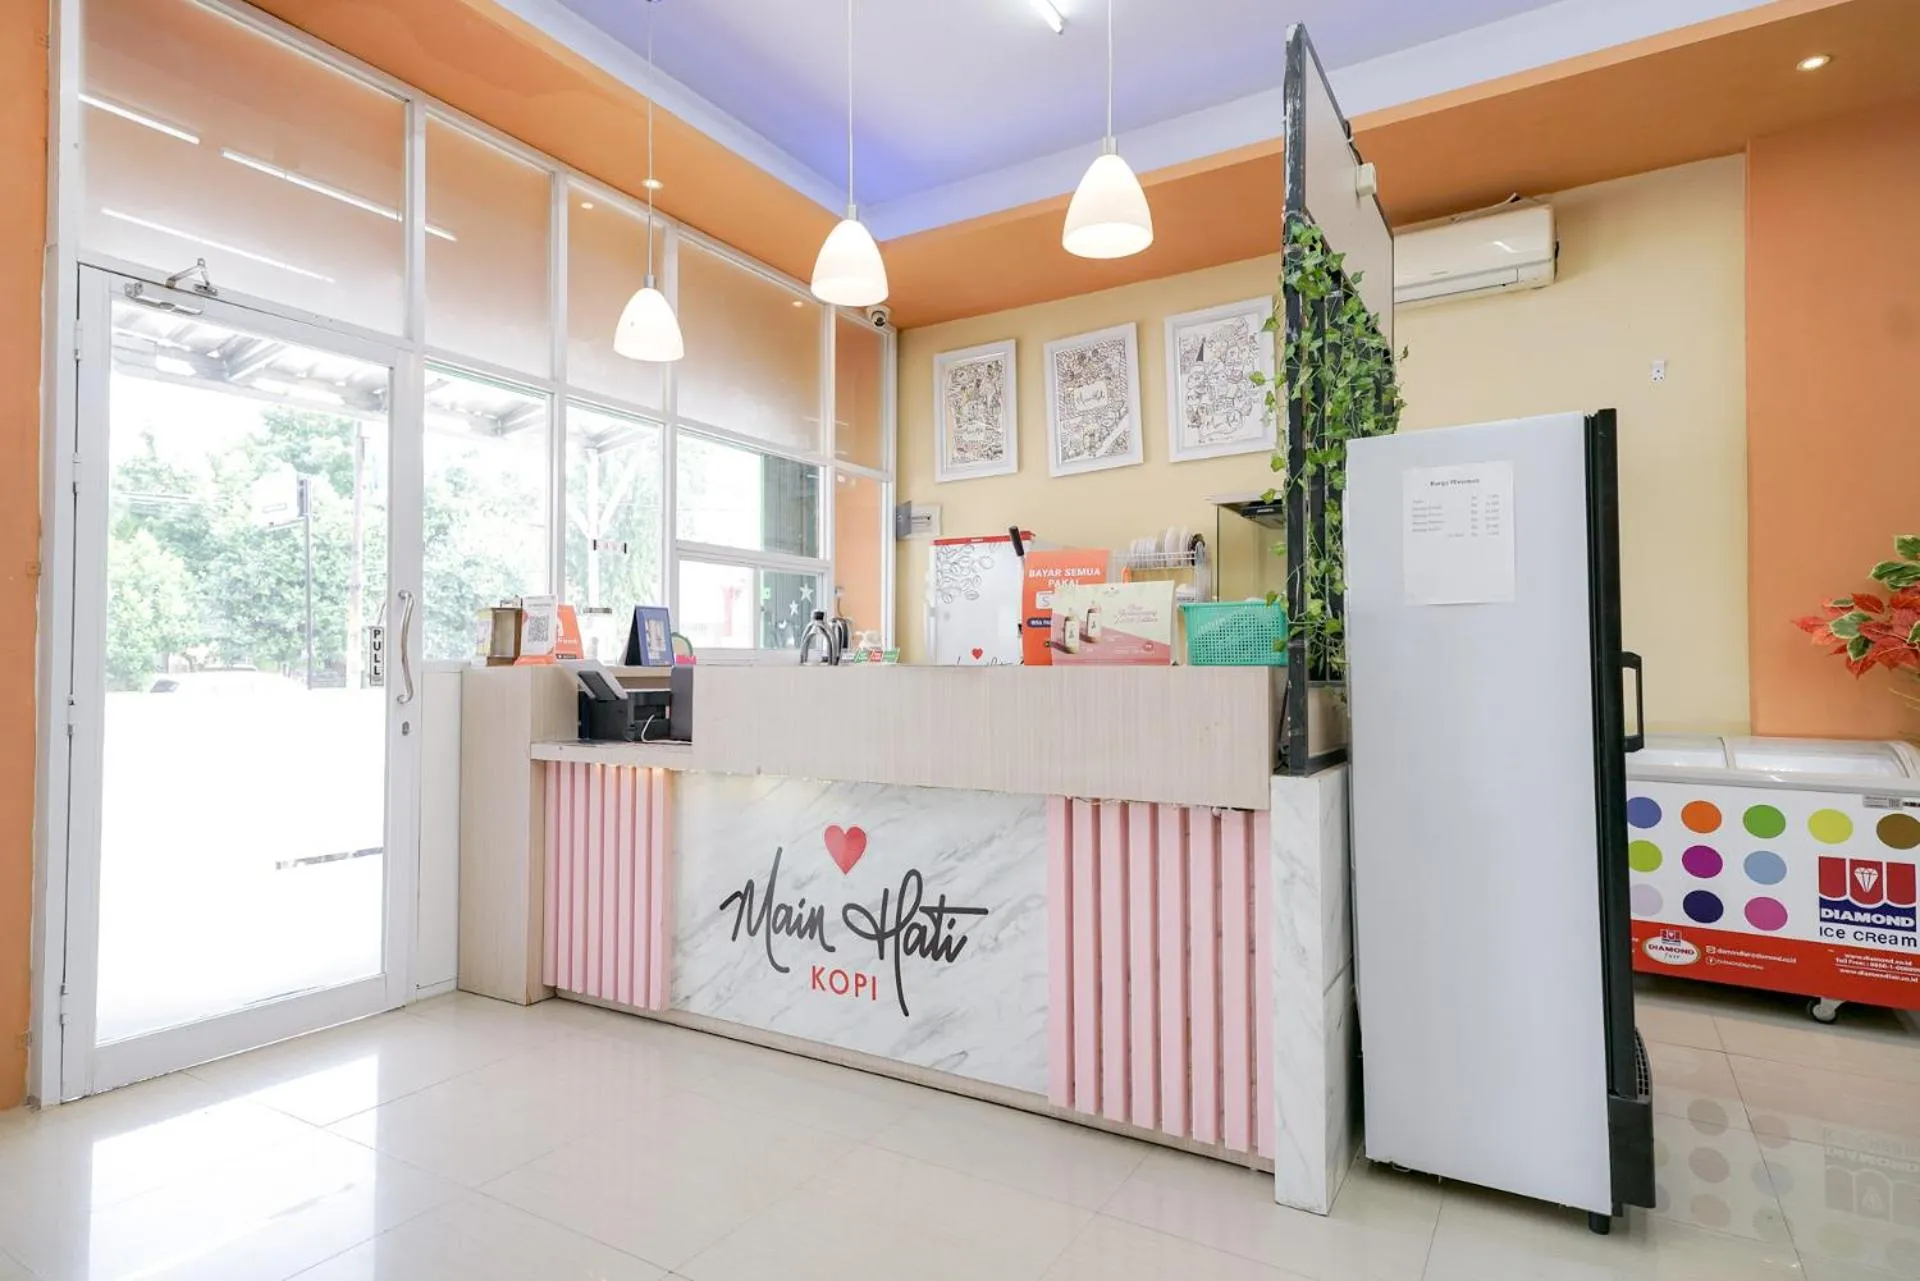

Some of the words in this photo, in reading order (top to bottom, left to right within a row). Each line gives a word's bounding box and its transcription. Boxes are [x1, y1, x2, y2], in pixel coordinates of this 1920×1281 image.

[1029, 568, 1061, 578] BAYAR
[1064, 567, 1101, 577] SEMUA
[373, 629, 381, 676] PULL
[719, 846, 836, 973] Main
[842, 868, 989, 1017] Hati
[1820, 907, 1915, 928] DIAMOND
[1648, 944, 1695, 955] DIAMOND
[811, 965, 878, 1001] KOPI
